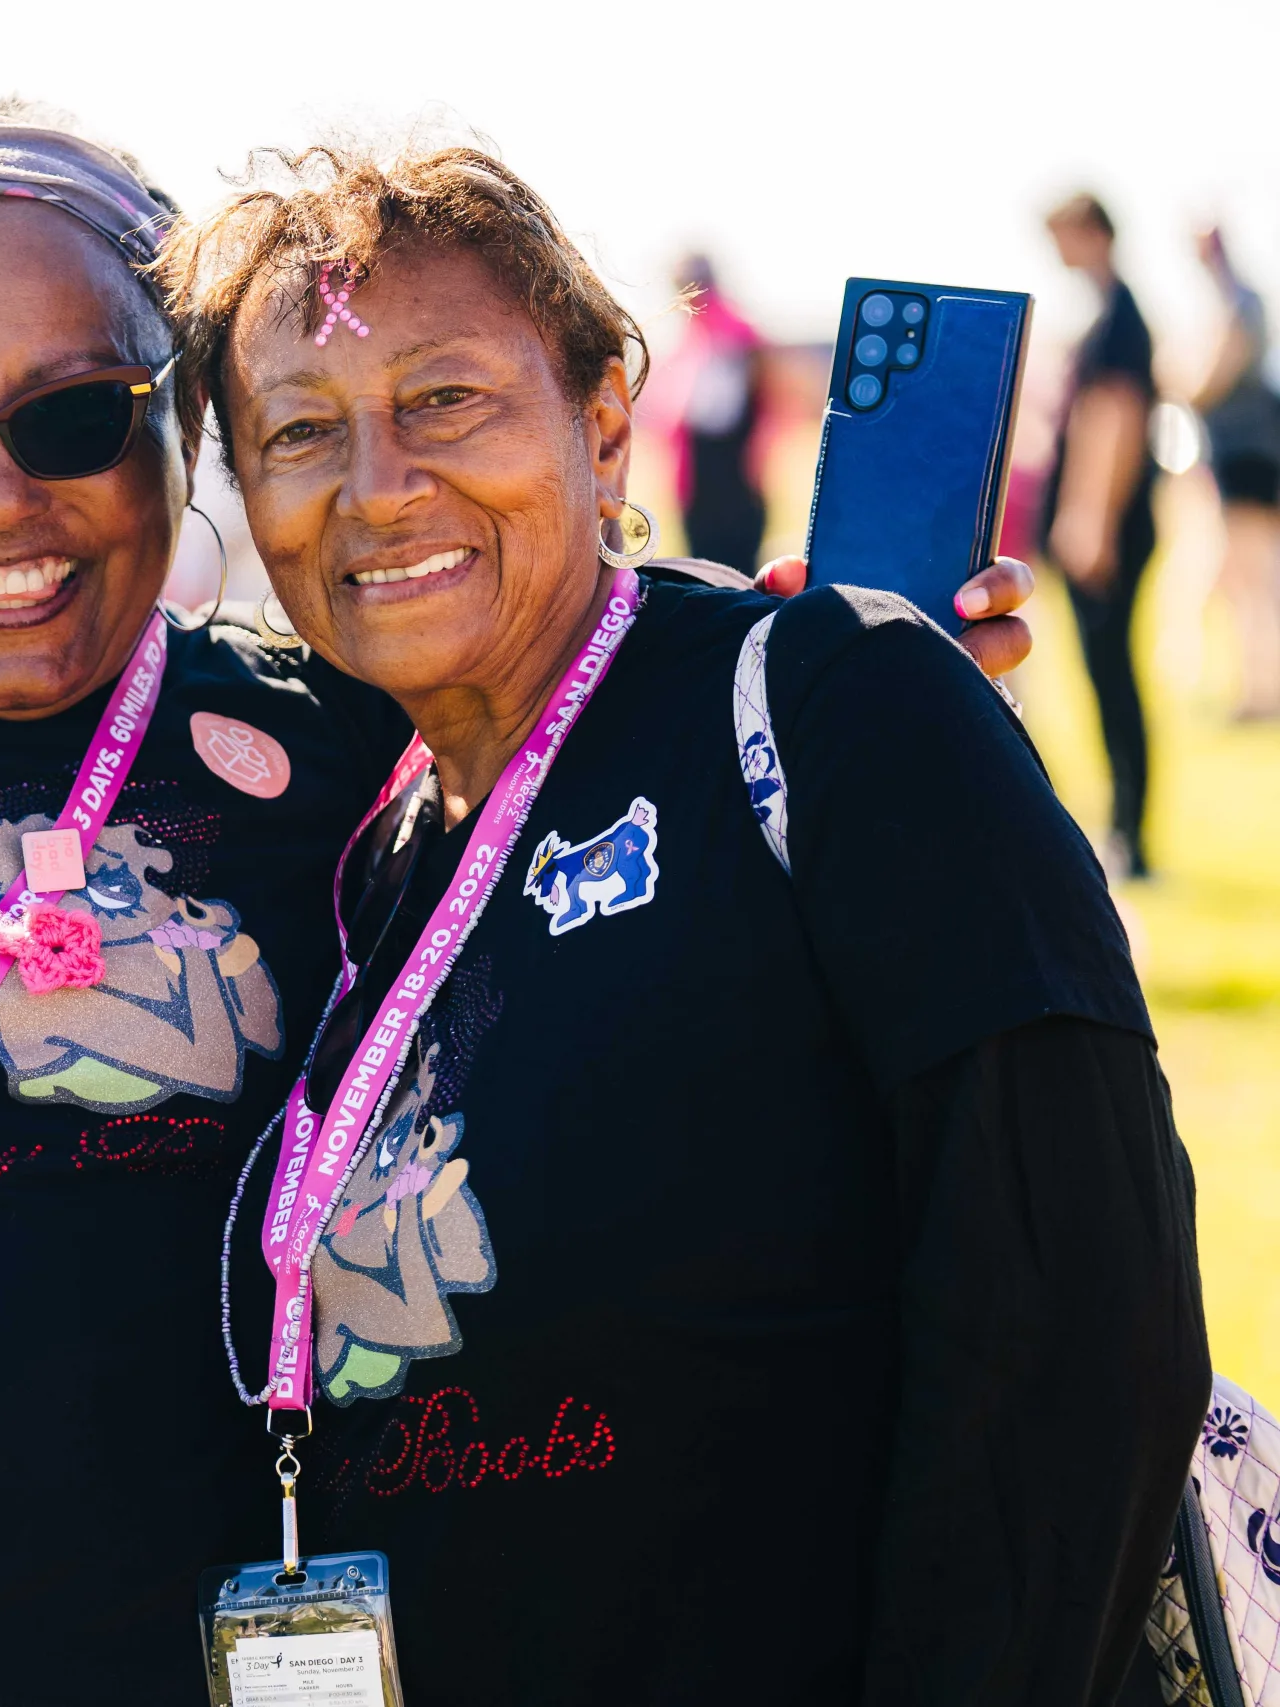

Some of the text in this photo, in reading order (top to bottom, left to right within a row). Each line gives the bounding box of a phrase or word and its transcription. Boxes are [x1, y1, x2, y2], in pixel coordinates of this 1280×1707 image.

[544, 681, 586, 736] SAN
[578, 597, 631, 675] DIEGO
[72, 806, 92, 830] 3
[109, 715, 137, 743] 60
[318, 844, 499, 1176] NOVEMBER 18-20, 2022
[289, 1656, 364, 1668] SAN DIEGO DAY 3
[296, 1668, 321, 1676] Sunday,
[322, 1667, 354, 1675] November
